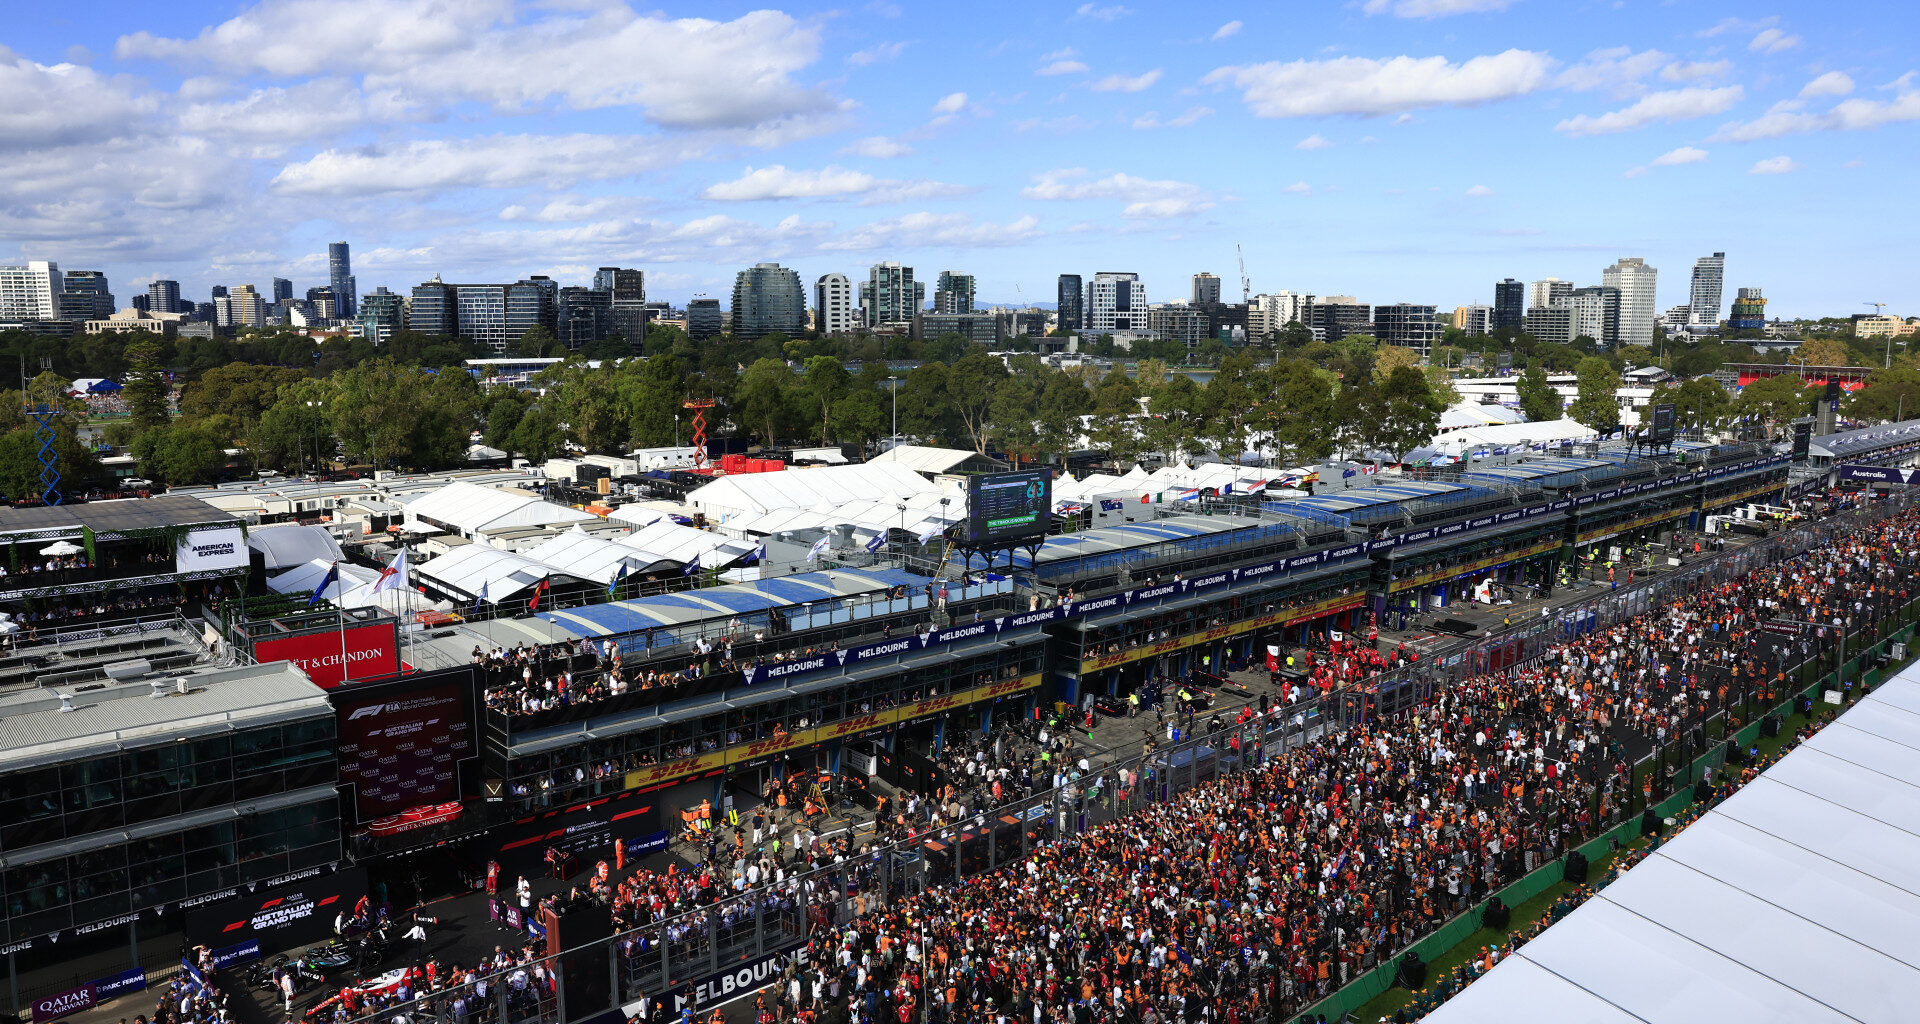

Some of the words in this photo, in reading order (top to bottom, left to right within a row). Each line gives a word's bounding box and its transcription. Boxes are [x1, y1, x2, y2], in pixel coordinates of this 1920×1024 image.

[1852, 470, 1886, 479] Australia
[192, 542, 234, 552] AMERICAN
[1372, 538, 1395, 549] MELBOURNE
[198, 549, 235, 557] EXPRESS
[1333, 546, 1358, 558] MELBOURNE
[1291, 555, 1318, 567] MELBOURNE
[1244, 564, 1274, 577] MELBOURNE
[1194, 574, 1227, 588] MELBOURNE
[0, 592, 23, 600] RESS
[1140, 585, 1174, 599] MELBOURNE
[1079, 598, 1117, 612] MELBOURNE
[1013, 611, 1055, 627] MELBOURNE
[939, 625, 985, 642] MELBOURNE
[858, 641, 909, 659] MELBOURNE
[312, 658, 320, 668] &
[322, 648, 382, 667] CHANDON
[1098, 652, 1127, 668] DHL
[768, 659, 824, 678] MELBOURNE
[989, 679, 1025, 695] DHL
[916, 696, 956, 714] DHL
[385, 722, 423, 733] AUSTRALIAN
[449, 722, 466, 730] QATAR
[836, 714, 878, 734] DHL
[386, 729, 407, 737] GRAND
[432, 735, 449, 743] QATAR
[396, 742, 414, 750] QATAR
[415, 748, 432, 756] QATAR
[748, 735, 797, 756] DHL
[650, 758, 702, 779] DHL
[362, 787, 380, 795] QATAR
[418, 816, 447, 828] CHANDON
[267, 867, 320, 887] MELBOURNE
[178, 888, 237, 909] MELBOURNE
[251, 902, 314, 924] AUSTRALIAN
[253, 915, 289, 930] GRAND
[289, 909, 312, 921] PRIX
[76, 913, 140, 935] MELBOURNE
[0, 941, 32, 955] URNE
[221, 951, 238, 962] PARC
[238, 945, 259, 958] FERMÉ
[102, 982, 121, 992] PARC
[122, 974, 144, 987] FERMÉ
[39, 989, 89, 1012] QATAR
[52, 998, 91, 1015] AIRWAYS
